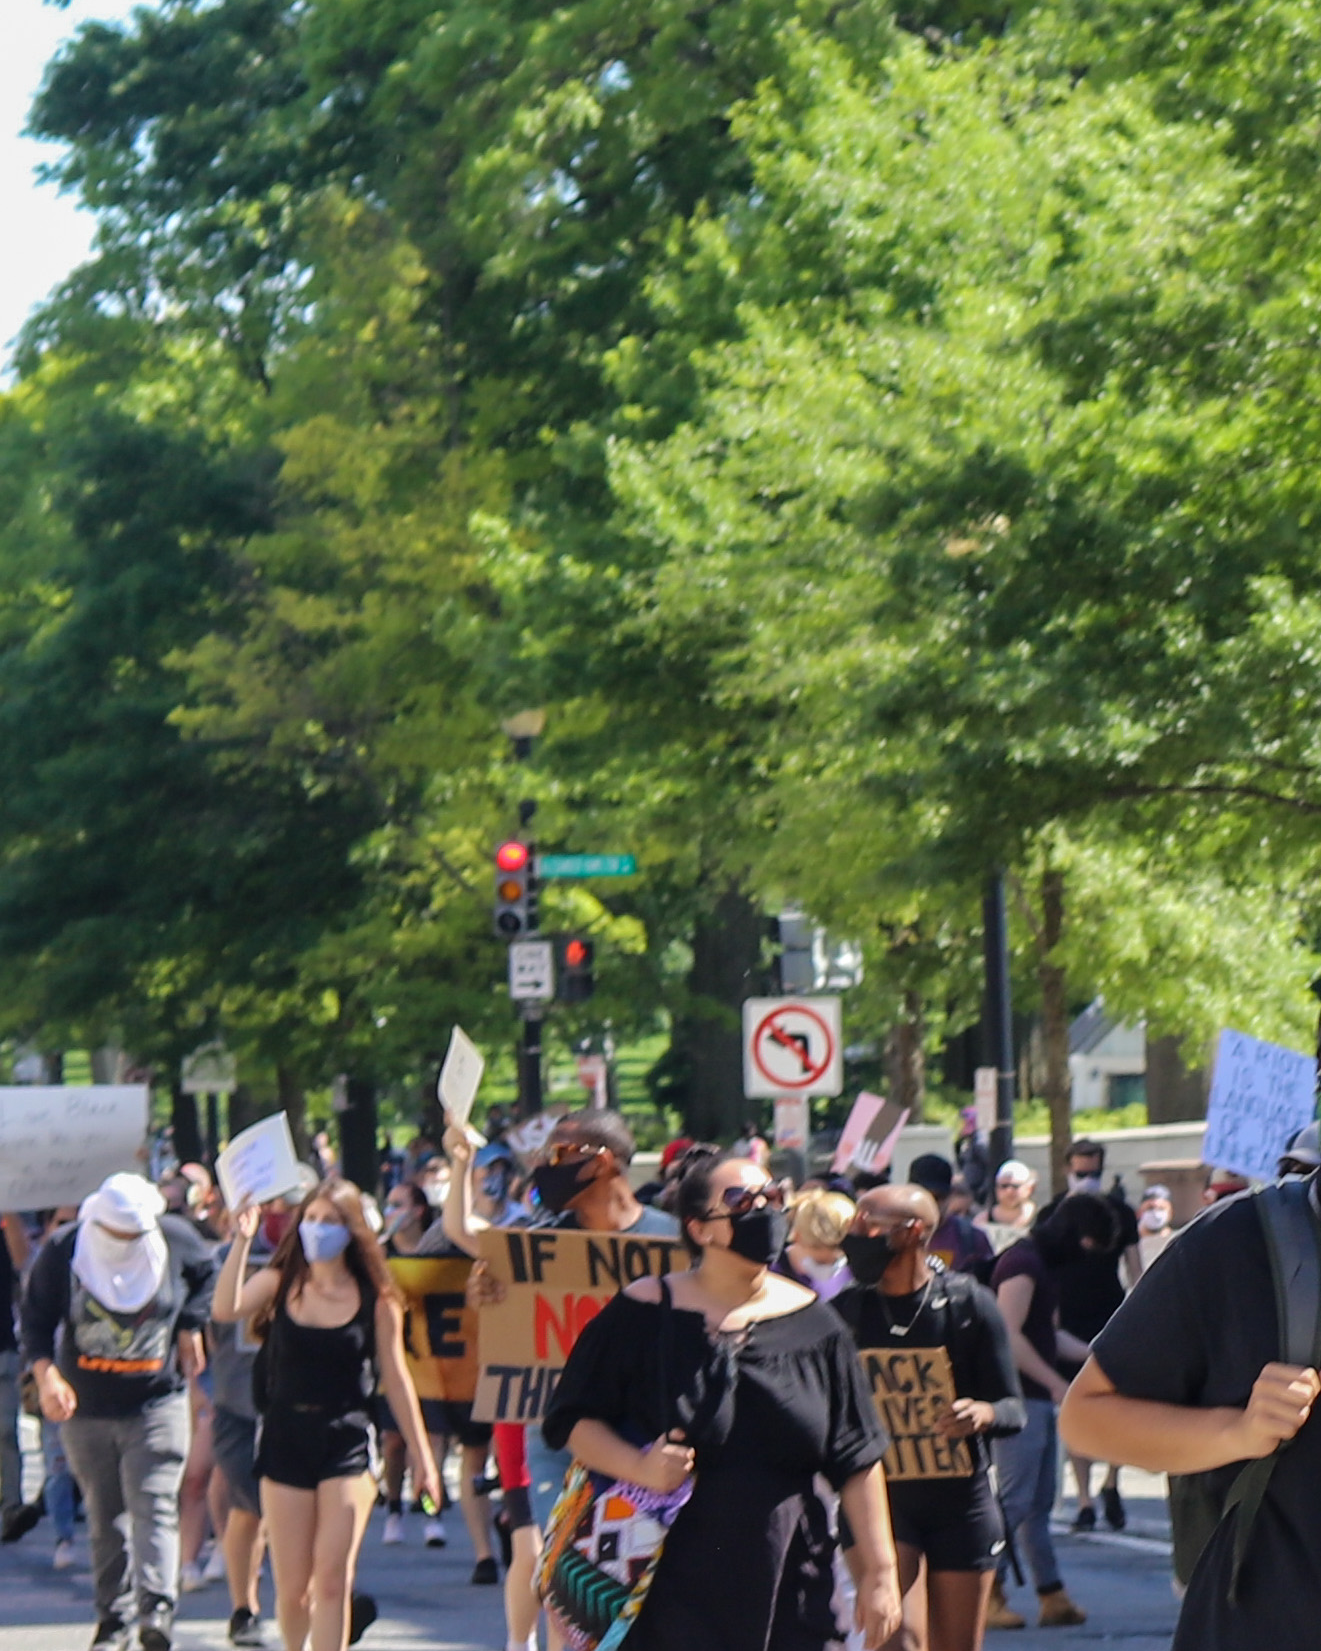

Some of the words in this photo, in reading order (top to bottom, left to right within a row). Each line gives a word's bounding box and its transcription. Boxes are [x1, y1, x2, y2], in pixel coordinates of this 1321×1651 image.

[506, 1233, 557, 1283] IF
[586, 1237, 682, 1288] NOT
[866, 1353, 944, 1394] ACK
